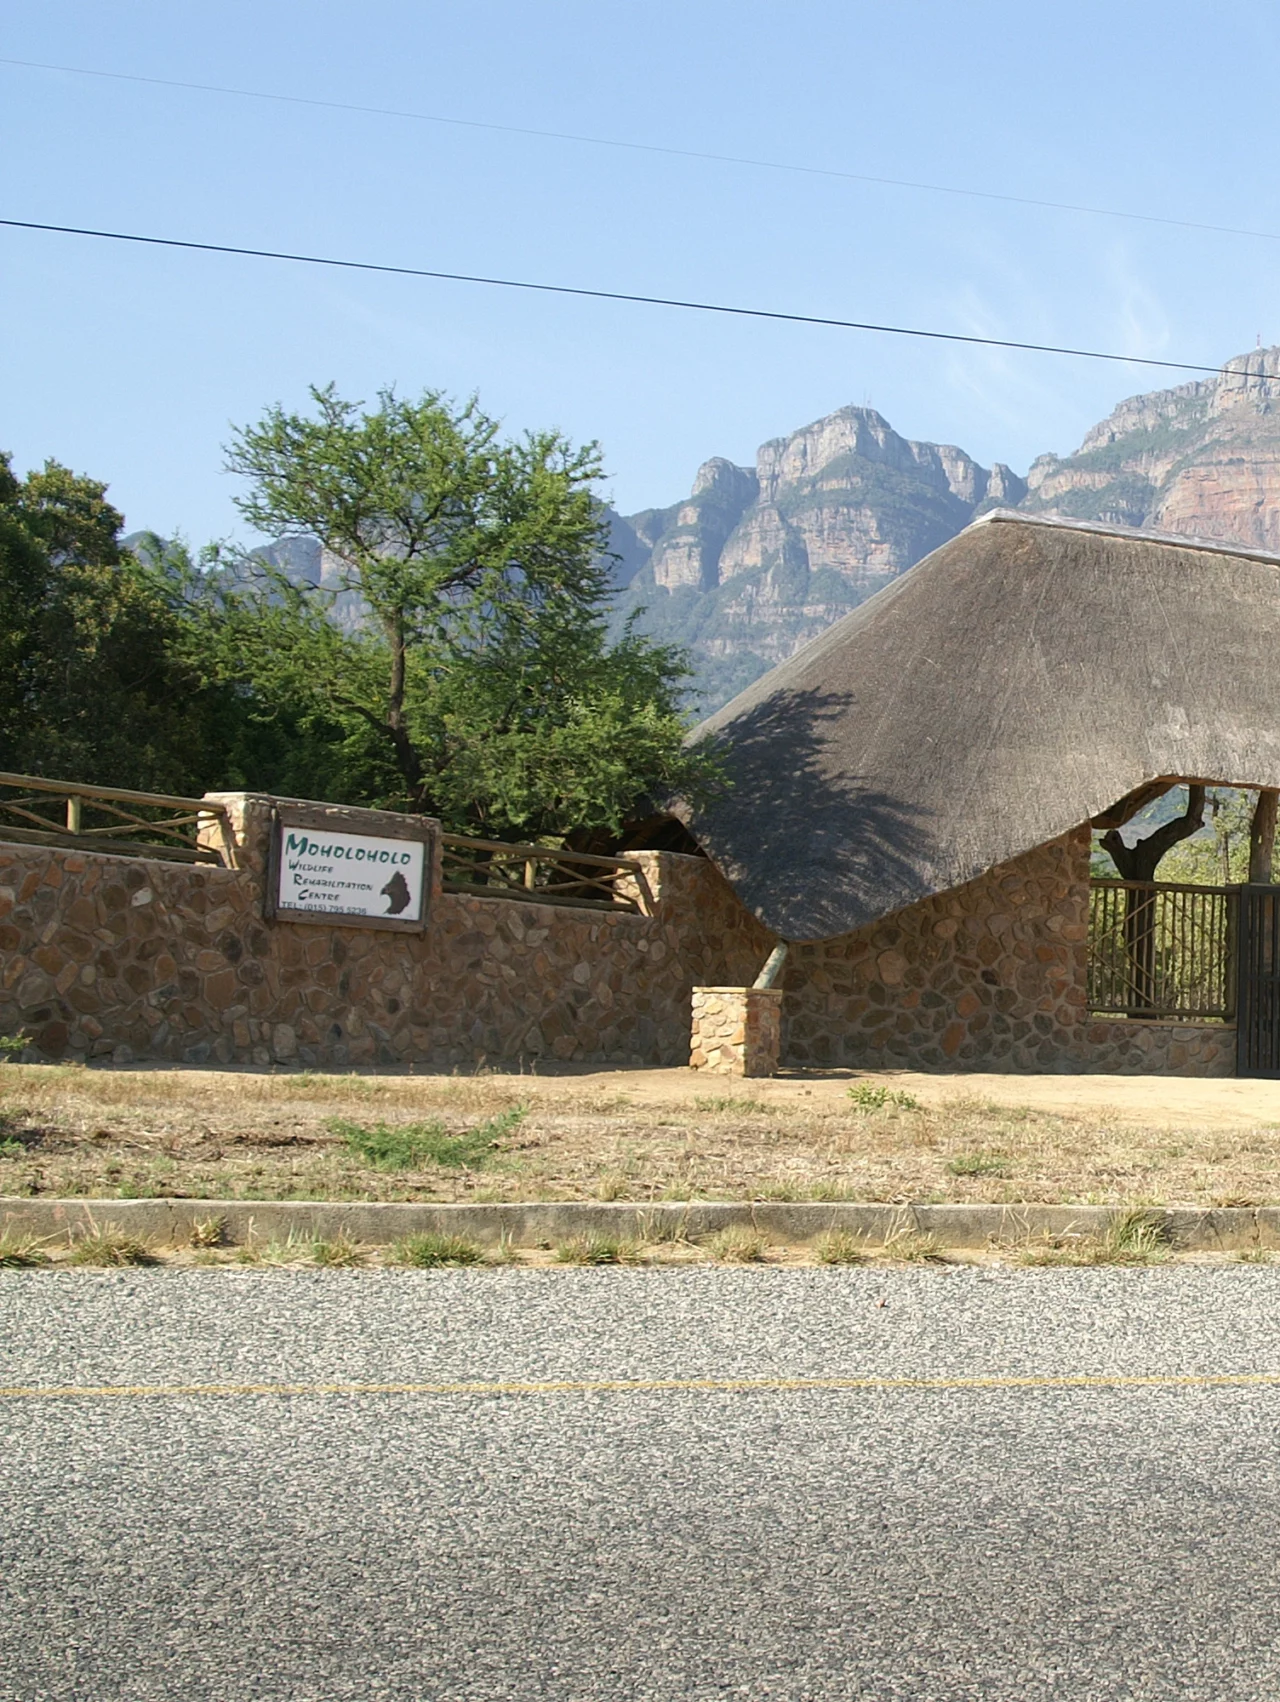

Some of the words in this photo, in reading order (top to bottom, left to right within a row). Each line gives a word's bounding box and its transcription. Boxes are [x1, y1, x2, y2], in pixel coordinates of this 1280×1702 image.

[285, 833, 411, 865] MOHOLOHOLO
[288, 859, 334, 873] WILDLIFE
[293, 873, 374, 891] REHABILITATION
[298, 889, 340, 901] CENTRE
[304, 903, 327, 912] (015)
[329, 905, 344, 913] 795
